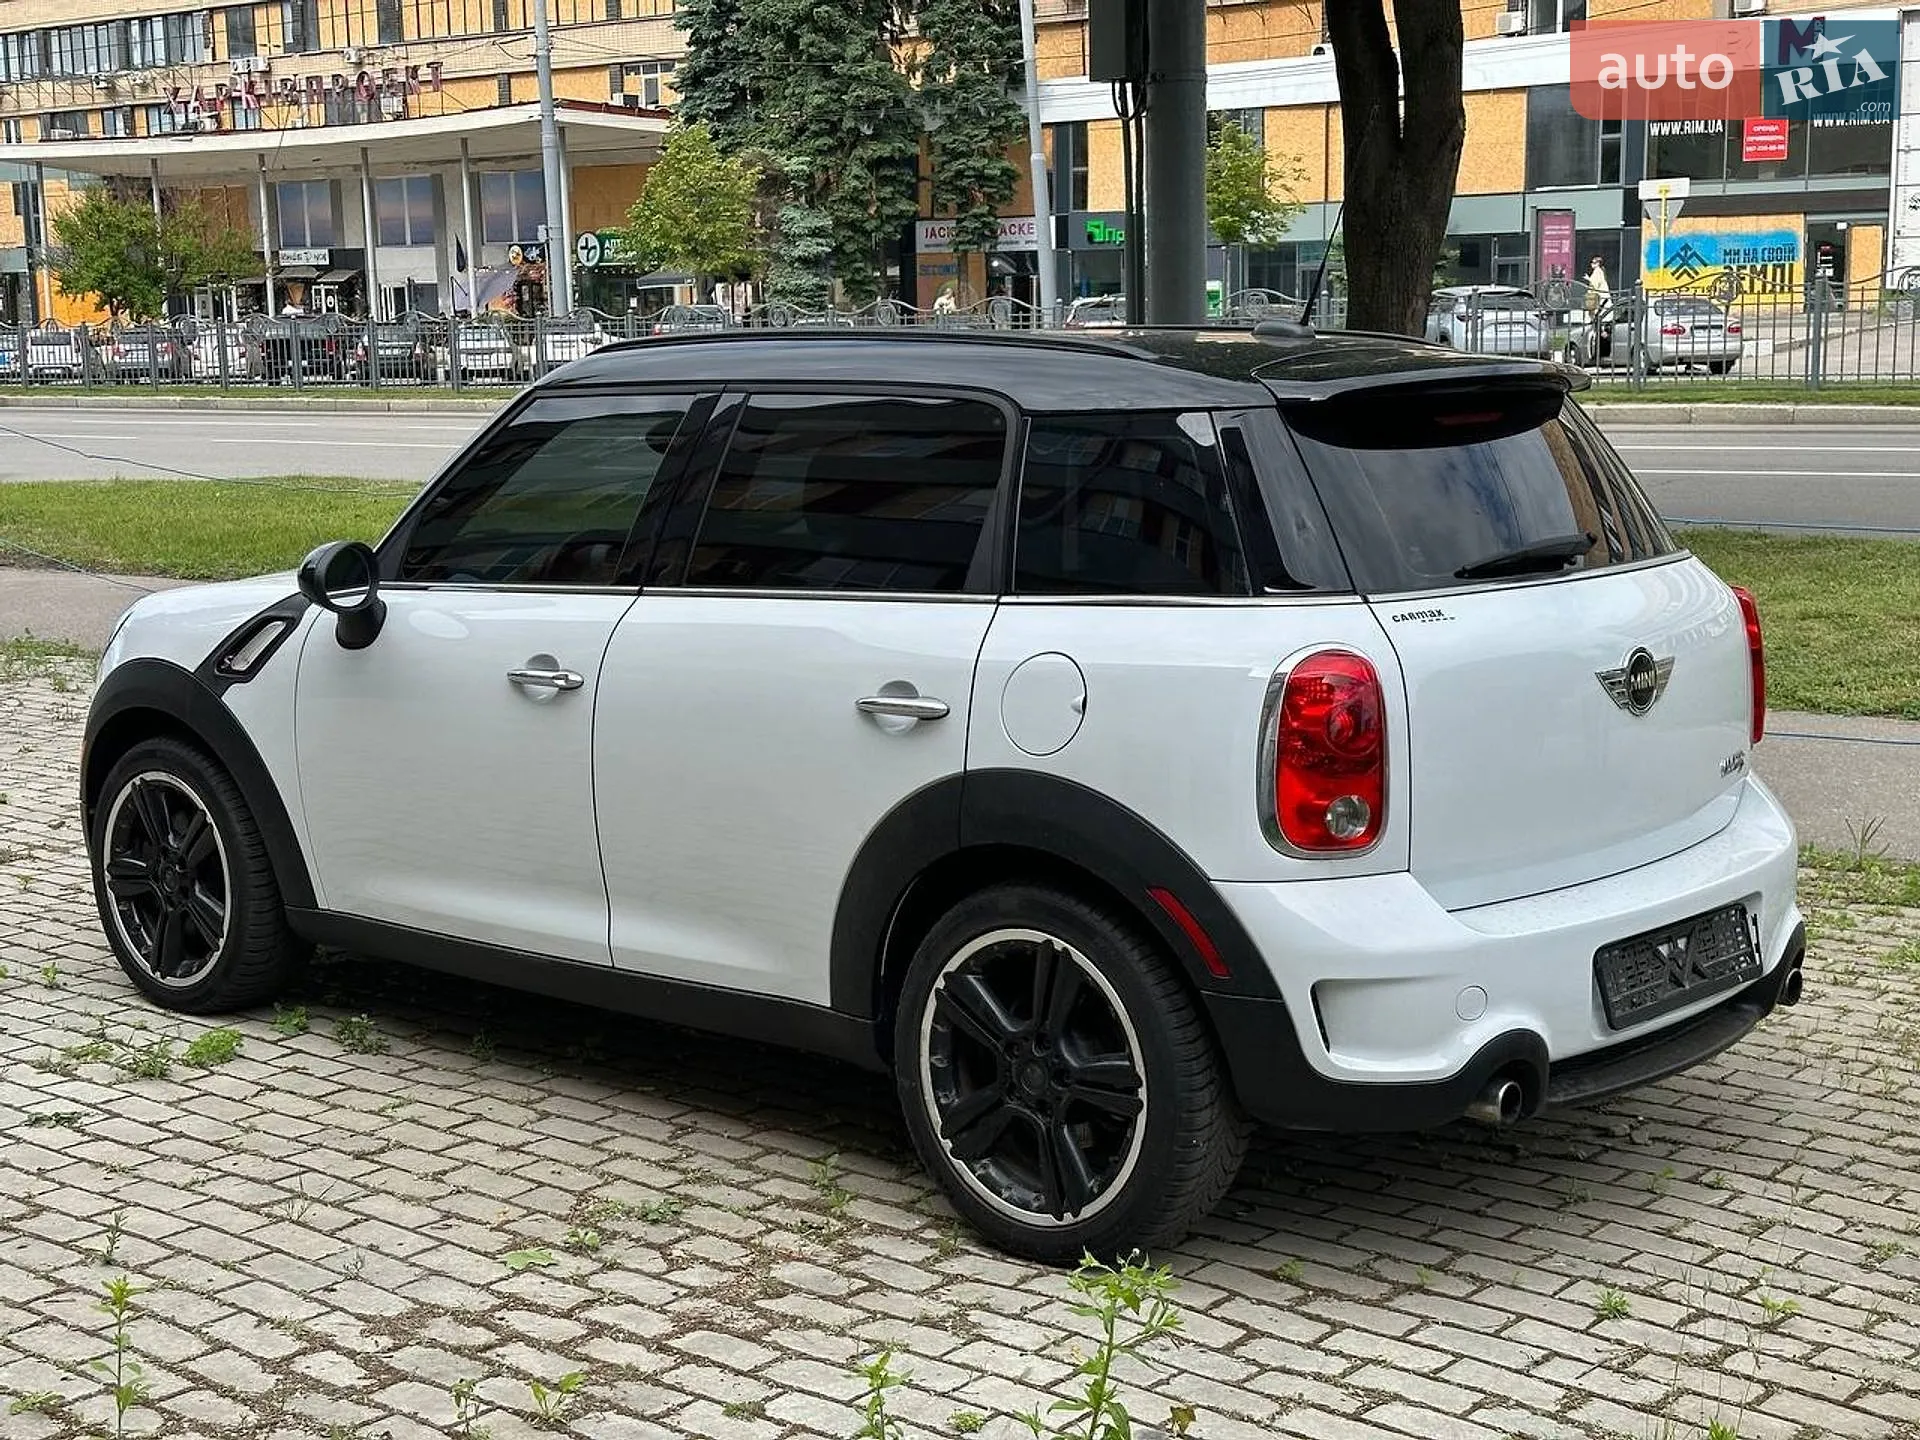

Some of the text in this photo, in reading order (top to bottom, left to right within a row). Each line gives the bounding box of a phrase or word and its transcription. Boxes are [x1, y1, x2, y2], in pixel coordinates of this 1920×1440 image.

[1650, 119, 1724, 136] WWW.RIM.UA
[1743, 247, 1758, 263] НА
[1630, 669, 1655, 691] MINI
